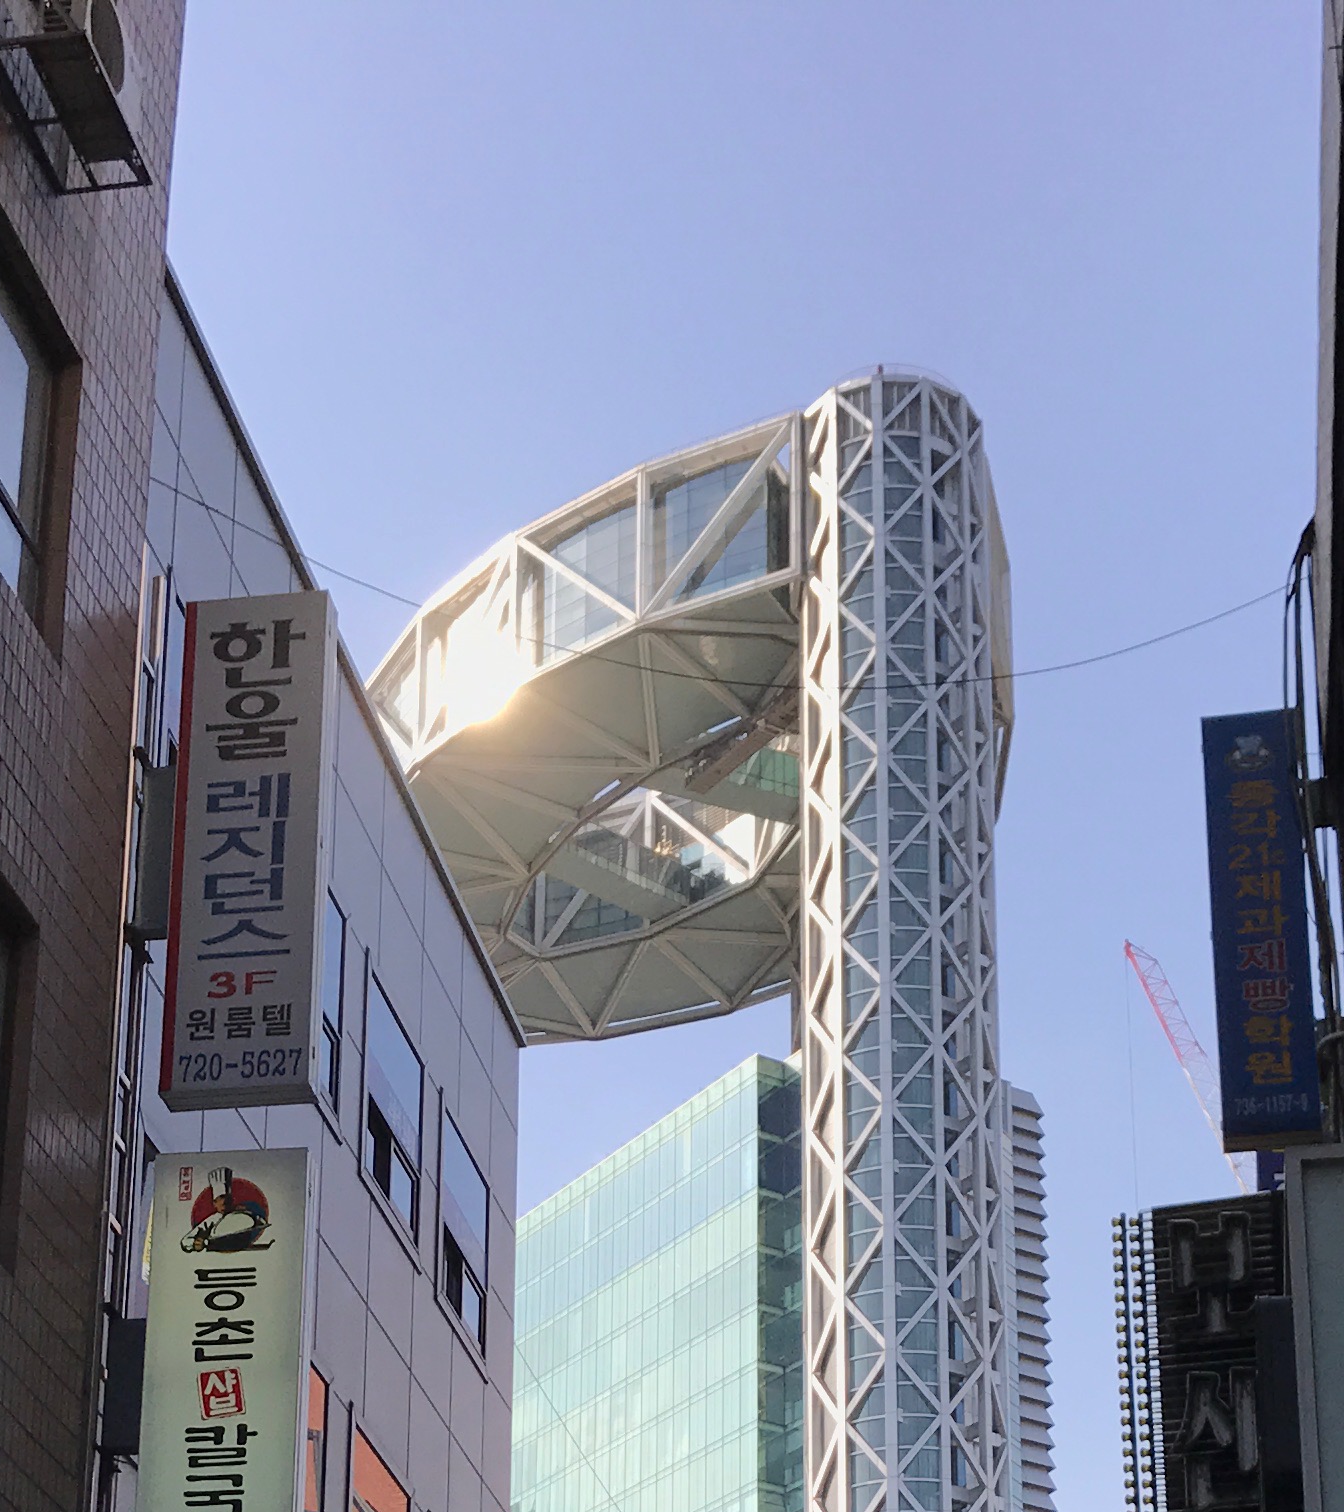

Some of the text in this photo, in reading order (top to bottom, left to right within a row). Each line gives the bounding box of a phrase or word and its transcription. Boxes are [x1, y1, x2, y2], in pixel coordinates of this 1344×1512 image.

[206, 619, 306, 761] 한울
[196, 771, 292, 961] 레지던스
[207, 969, 278, 1000] 3F
[186, 1002, 293, 1042] 원룸텔
[178, 1048, 303, 1083] 720-5627
